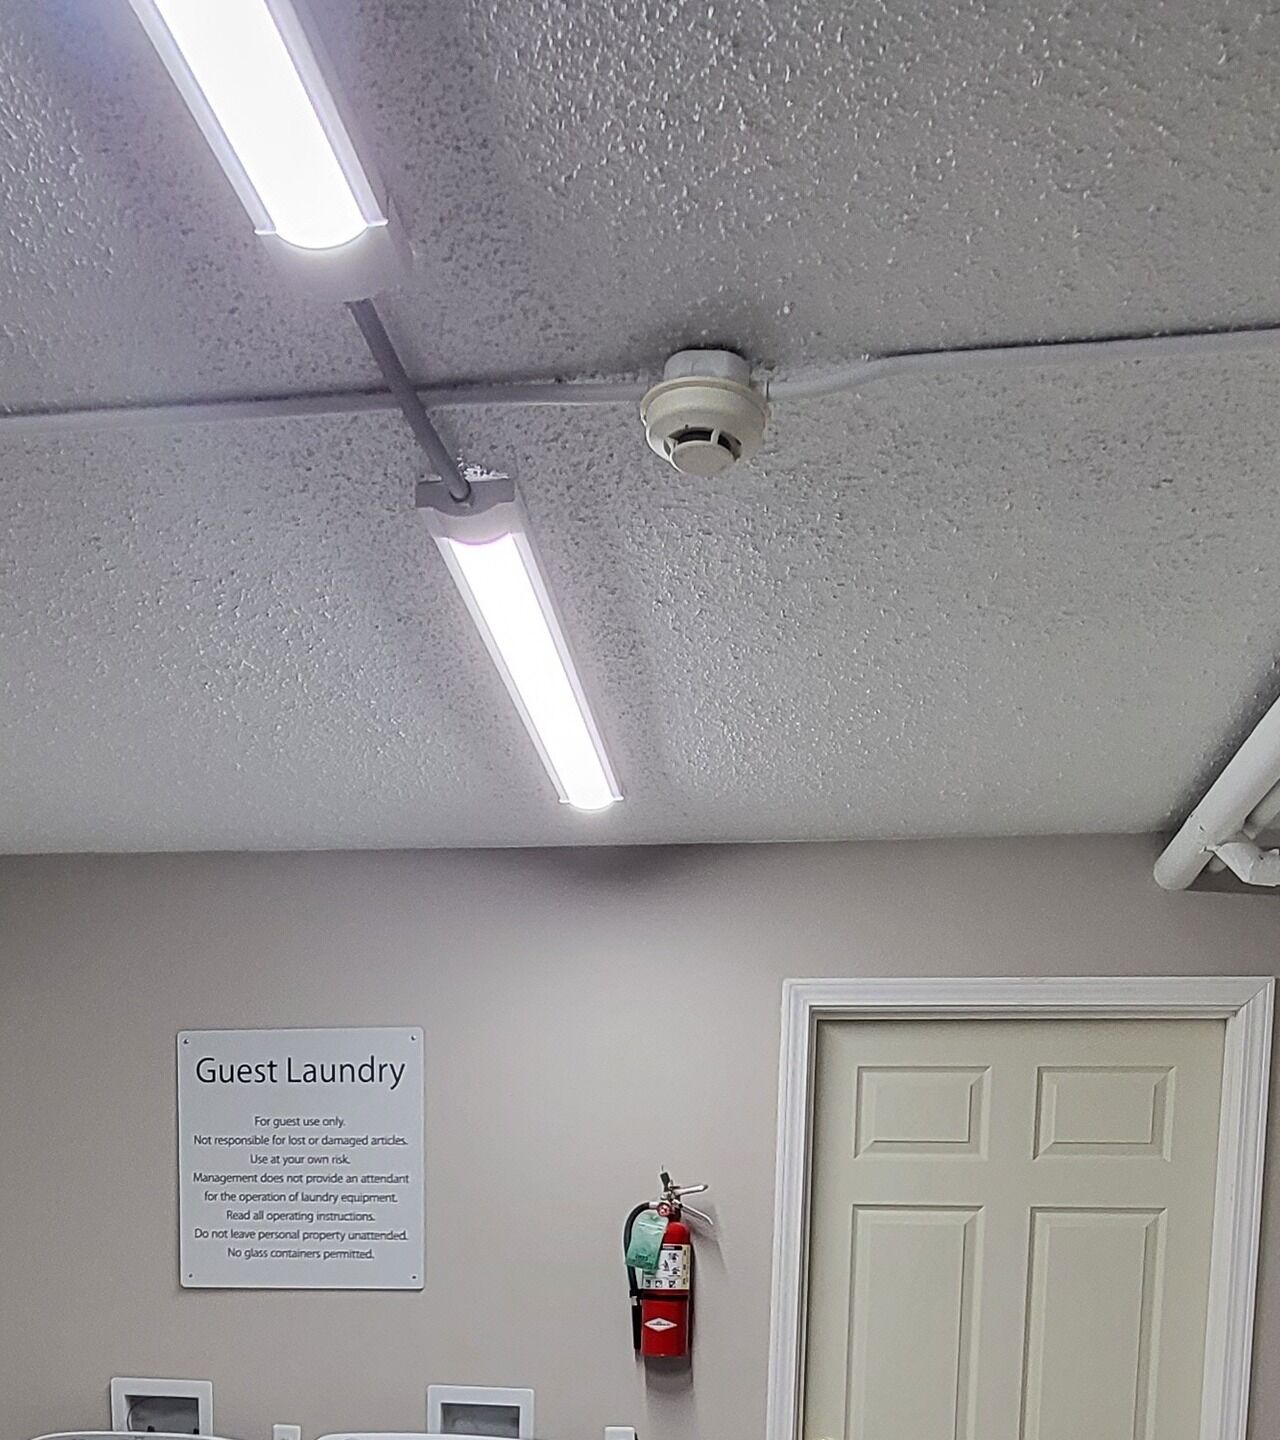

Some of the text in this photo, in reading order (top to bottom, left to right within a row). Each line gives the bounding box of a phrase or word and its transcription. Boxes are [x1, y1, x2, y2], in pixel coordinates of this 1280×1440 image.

[196, 1055, 406, 1090] Guest Laundry
[254, 1116, 346, 1128] For guest use only.
[194, 1135, 212, 1145] Not
[215, 1135, 269, 1147] responsible
[272, 1135, 286, 1145] for
[288, 1136, 306, 1145] lost
[308, 1137, 319, 1145] or
[321, 1135, 369, 1147] damaged
[250, 1154, 269, 1164] Use
[270, 1155, 280, 1164] at
[282, 1156, 305, 1166] your
[307, 1156, 329, 1164] own
[193, 1173, 409, 1185] Management does not provide an attendant
[204, 1191, 218, 1201] for
[220, 1192, 237, 1201] the
[239, 1192, 286, 1203] operation
[288, 1192, 299, 1201] of
[301, 1192, 338, 1204] laundry
[226, 1210, 375, 1223] Read all operating instructions.
[194, 1228, 408, 1242] Do not leave personal property unattended.
[227, 1248, 375, 1260] No glass containers permitted.
